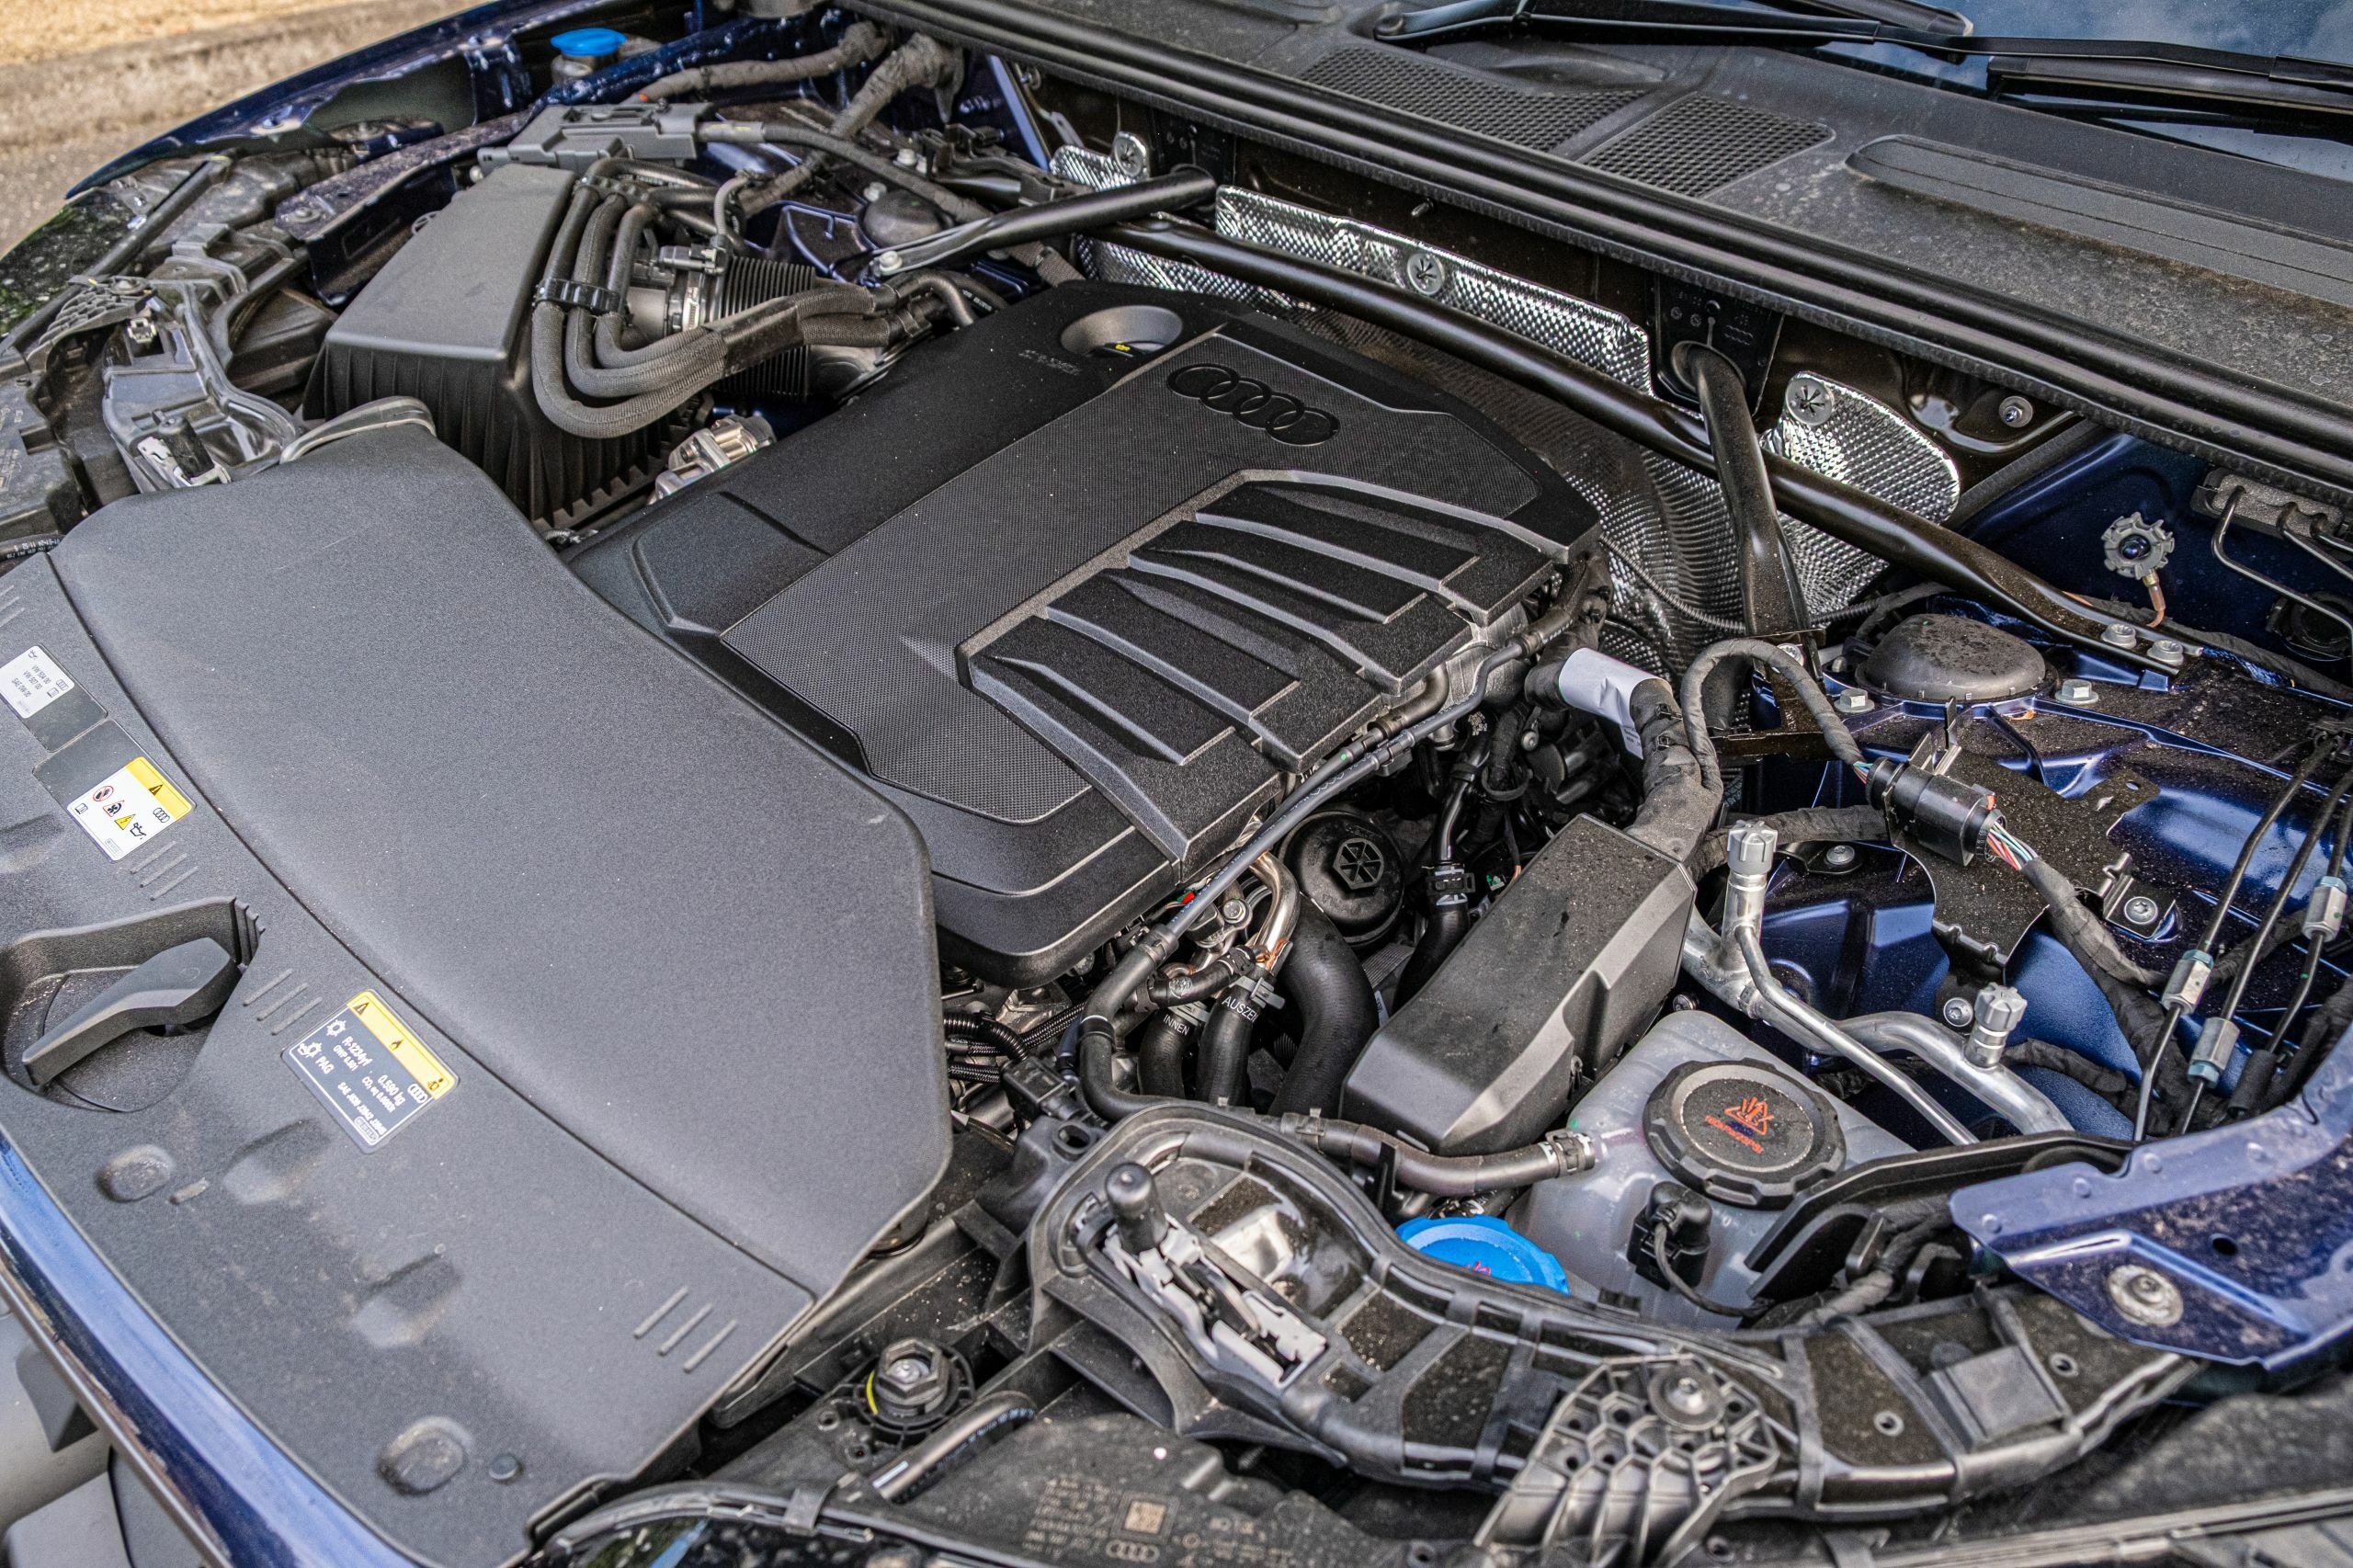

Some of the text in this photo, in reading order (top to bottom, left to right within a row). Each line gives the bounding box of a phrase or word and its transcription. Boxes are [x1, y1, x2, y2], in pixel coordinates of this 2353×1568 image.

[1221, 994, 1259, 1022] AUSZEN
[1163, 1014, 1189, 1036] INNEN
[315, 1055, 335, 1074] PAG
[341, 1035, 406, 1107] R-1234yf 0.590 kg
